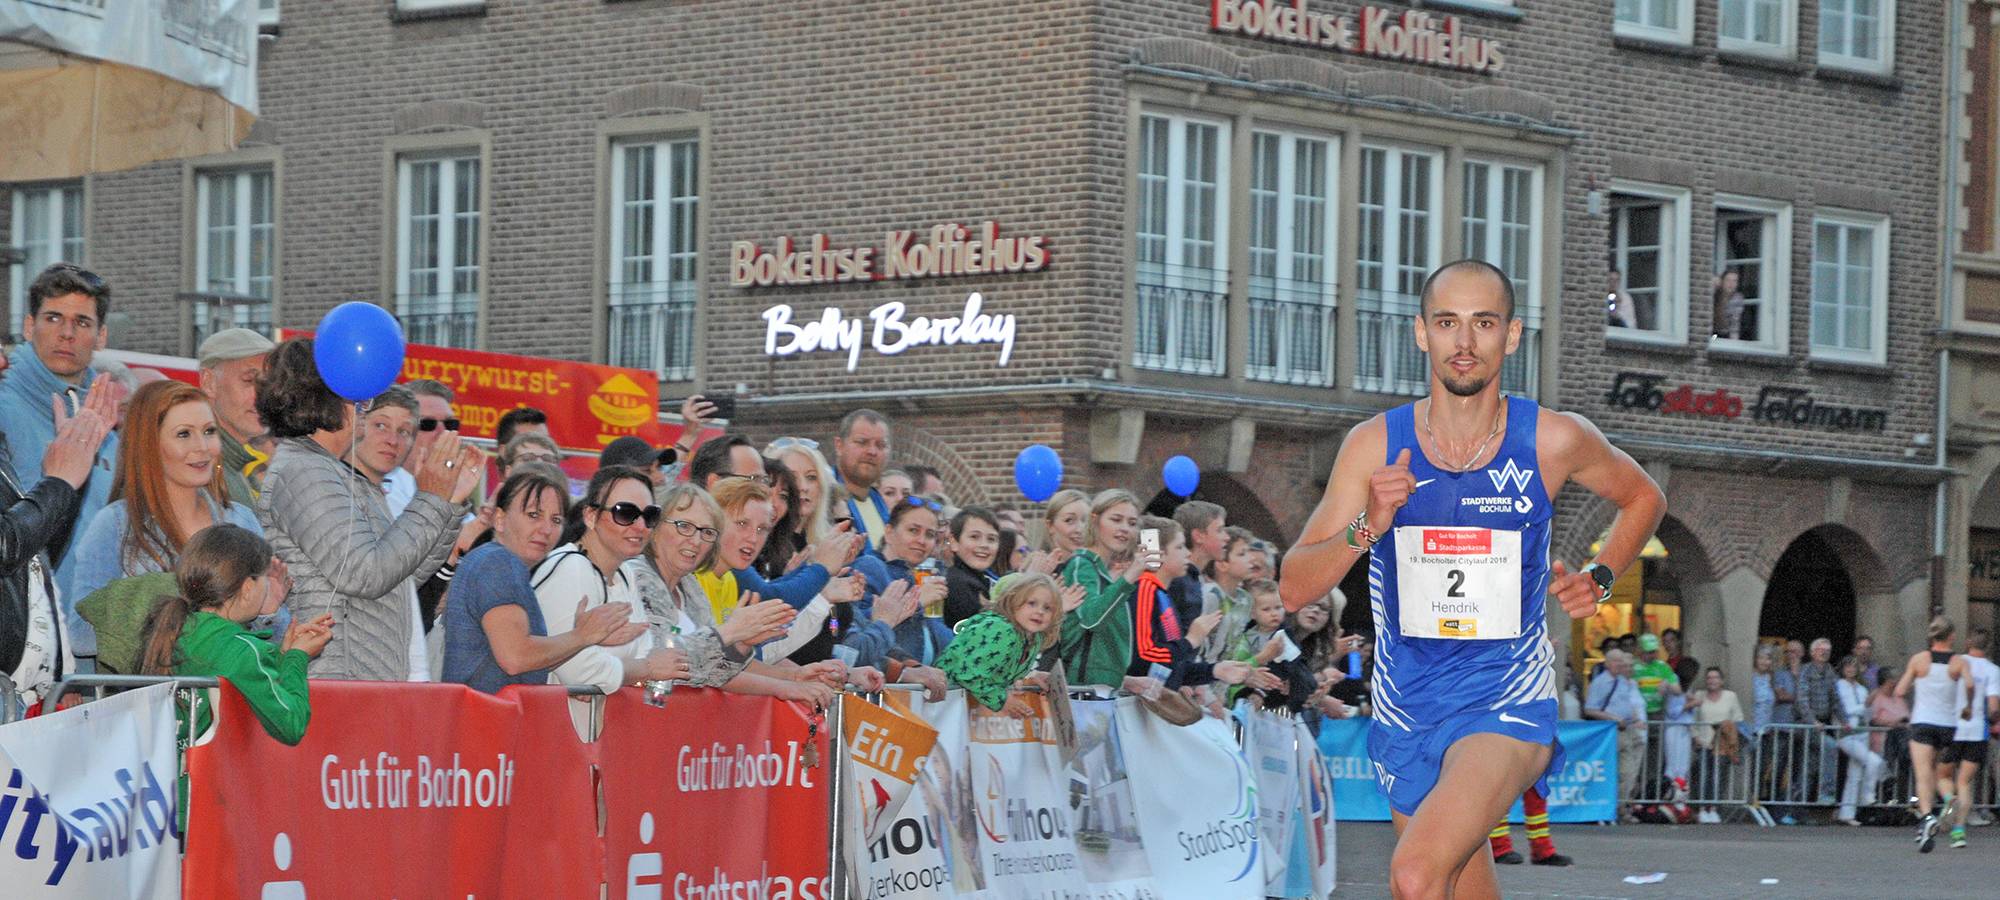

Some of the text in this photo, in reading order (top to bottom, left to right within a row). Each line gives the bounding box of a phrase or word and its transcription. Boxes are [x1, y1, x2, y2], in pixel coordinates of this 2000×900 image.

[762, 292, 1017, 372] Betty Barclay
[402, 356, 572, 395] urrywurst-
[1461, 496, 1513, 506] STADTWERKE
[1479, 505, 1513, 513] BOCHUM
[1421, 556, 1456, 564] Bocholter
[1458, 556, 1488, 566] Citylauf
[1490, 556, 1508, 564] 2018
[1439, 543, 1487, 552] Stadtsparkasse
[1447, 569, 1466, 598] 2
[1431, 602, 1480, 613] Hendrik
[850, 719, 903, 773] Ein
[320, 753, 372, 810] Gut
[376, 751, 412, 809] für
[677, 744, 709, 792] Gut
